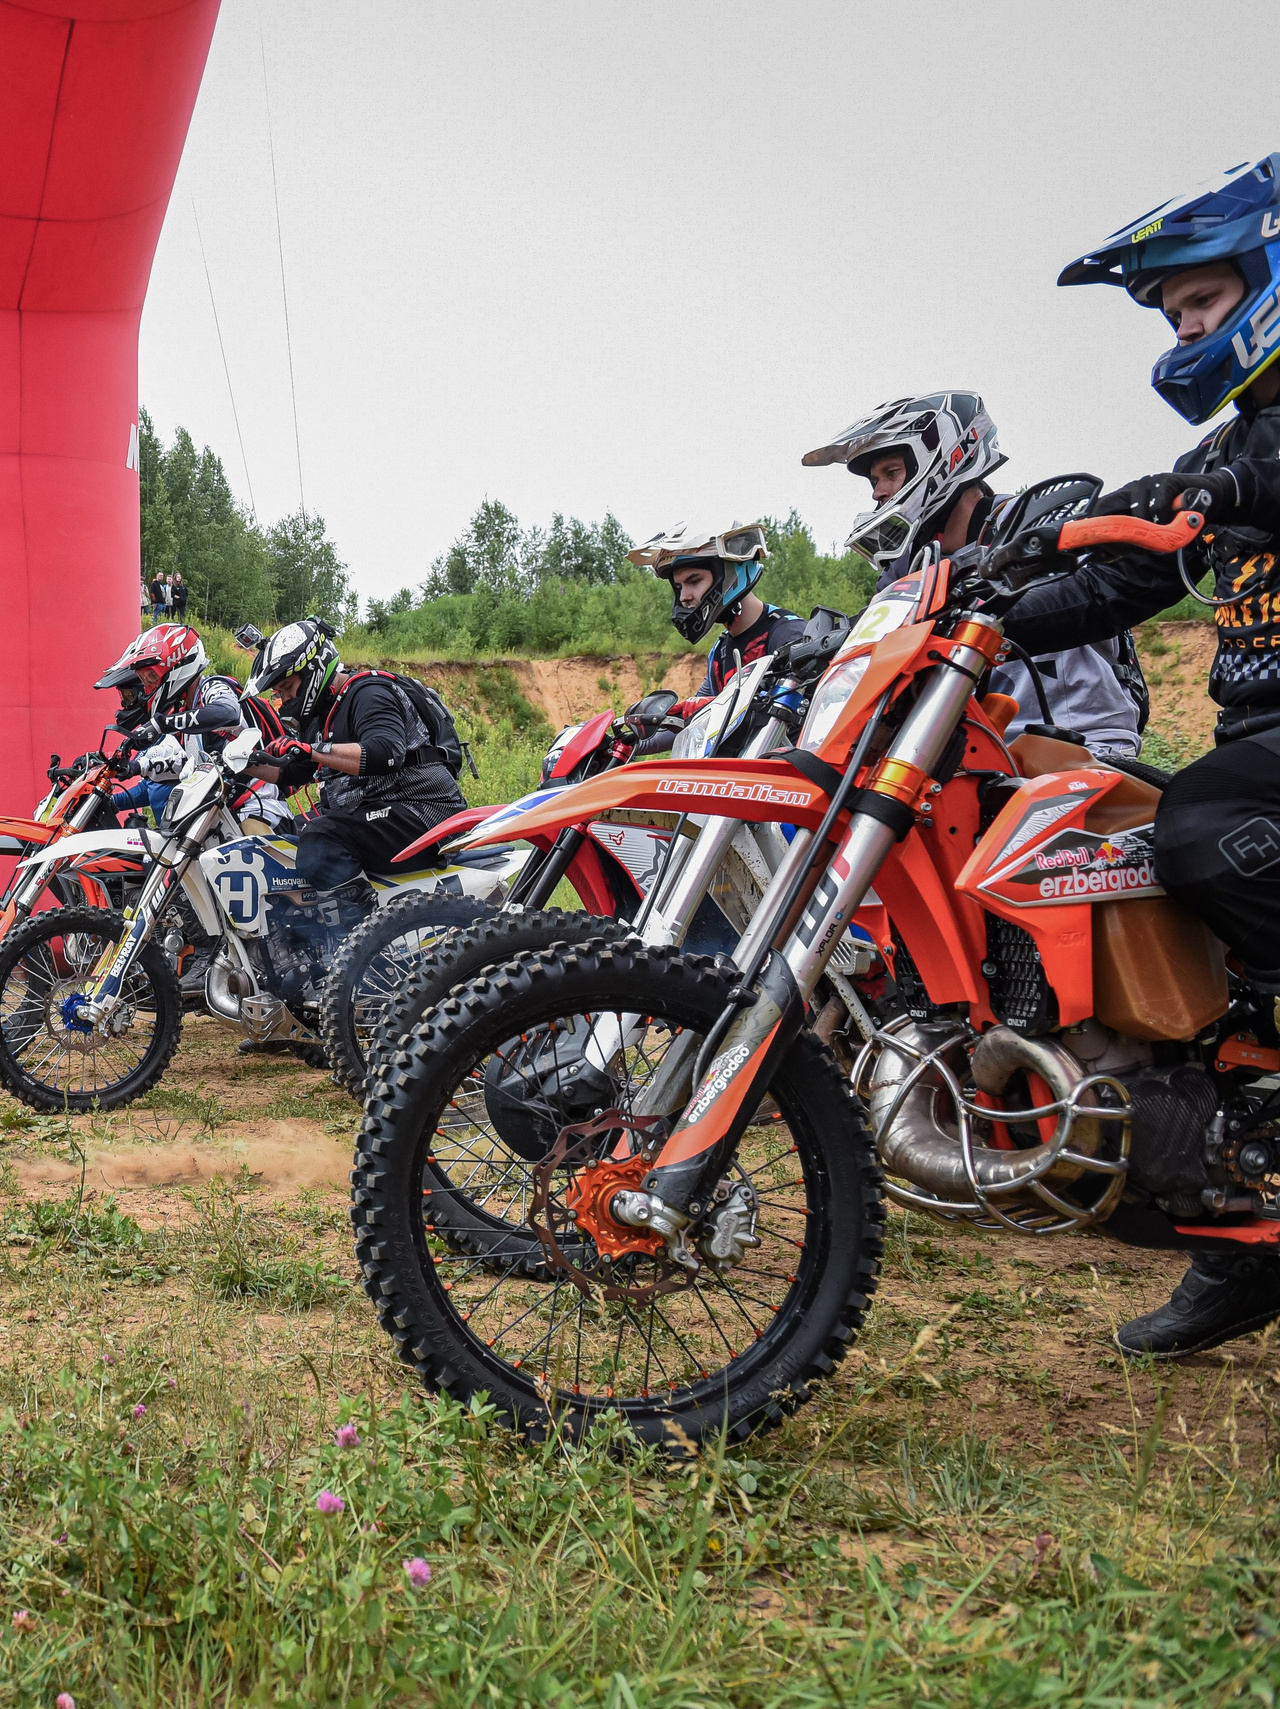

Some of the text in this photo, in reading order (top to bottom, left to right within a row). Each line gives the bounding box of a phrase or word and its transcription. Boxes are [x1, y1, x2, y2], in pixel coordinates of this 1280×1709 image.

[1131, 218, 1164, 244] LEATT
[921, 427, 979, 507] ATAKI
[815, 922, 842, 957] XPLOR
[688, 1046, 750, 1123] erzbergrodeo
